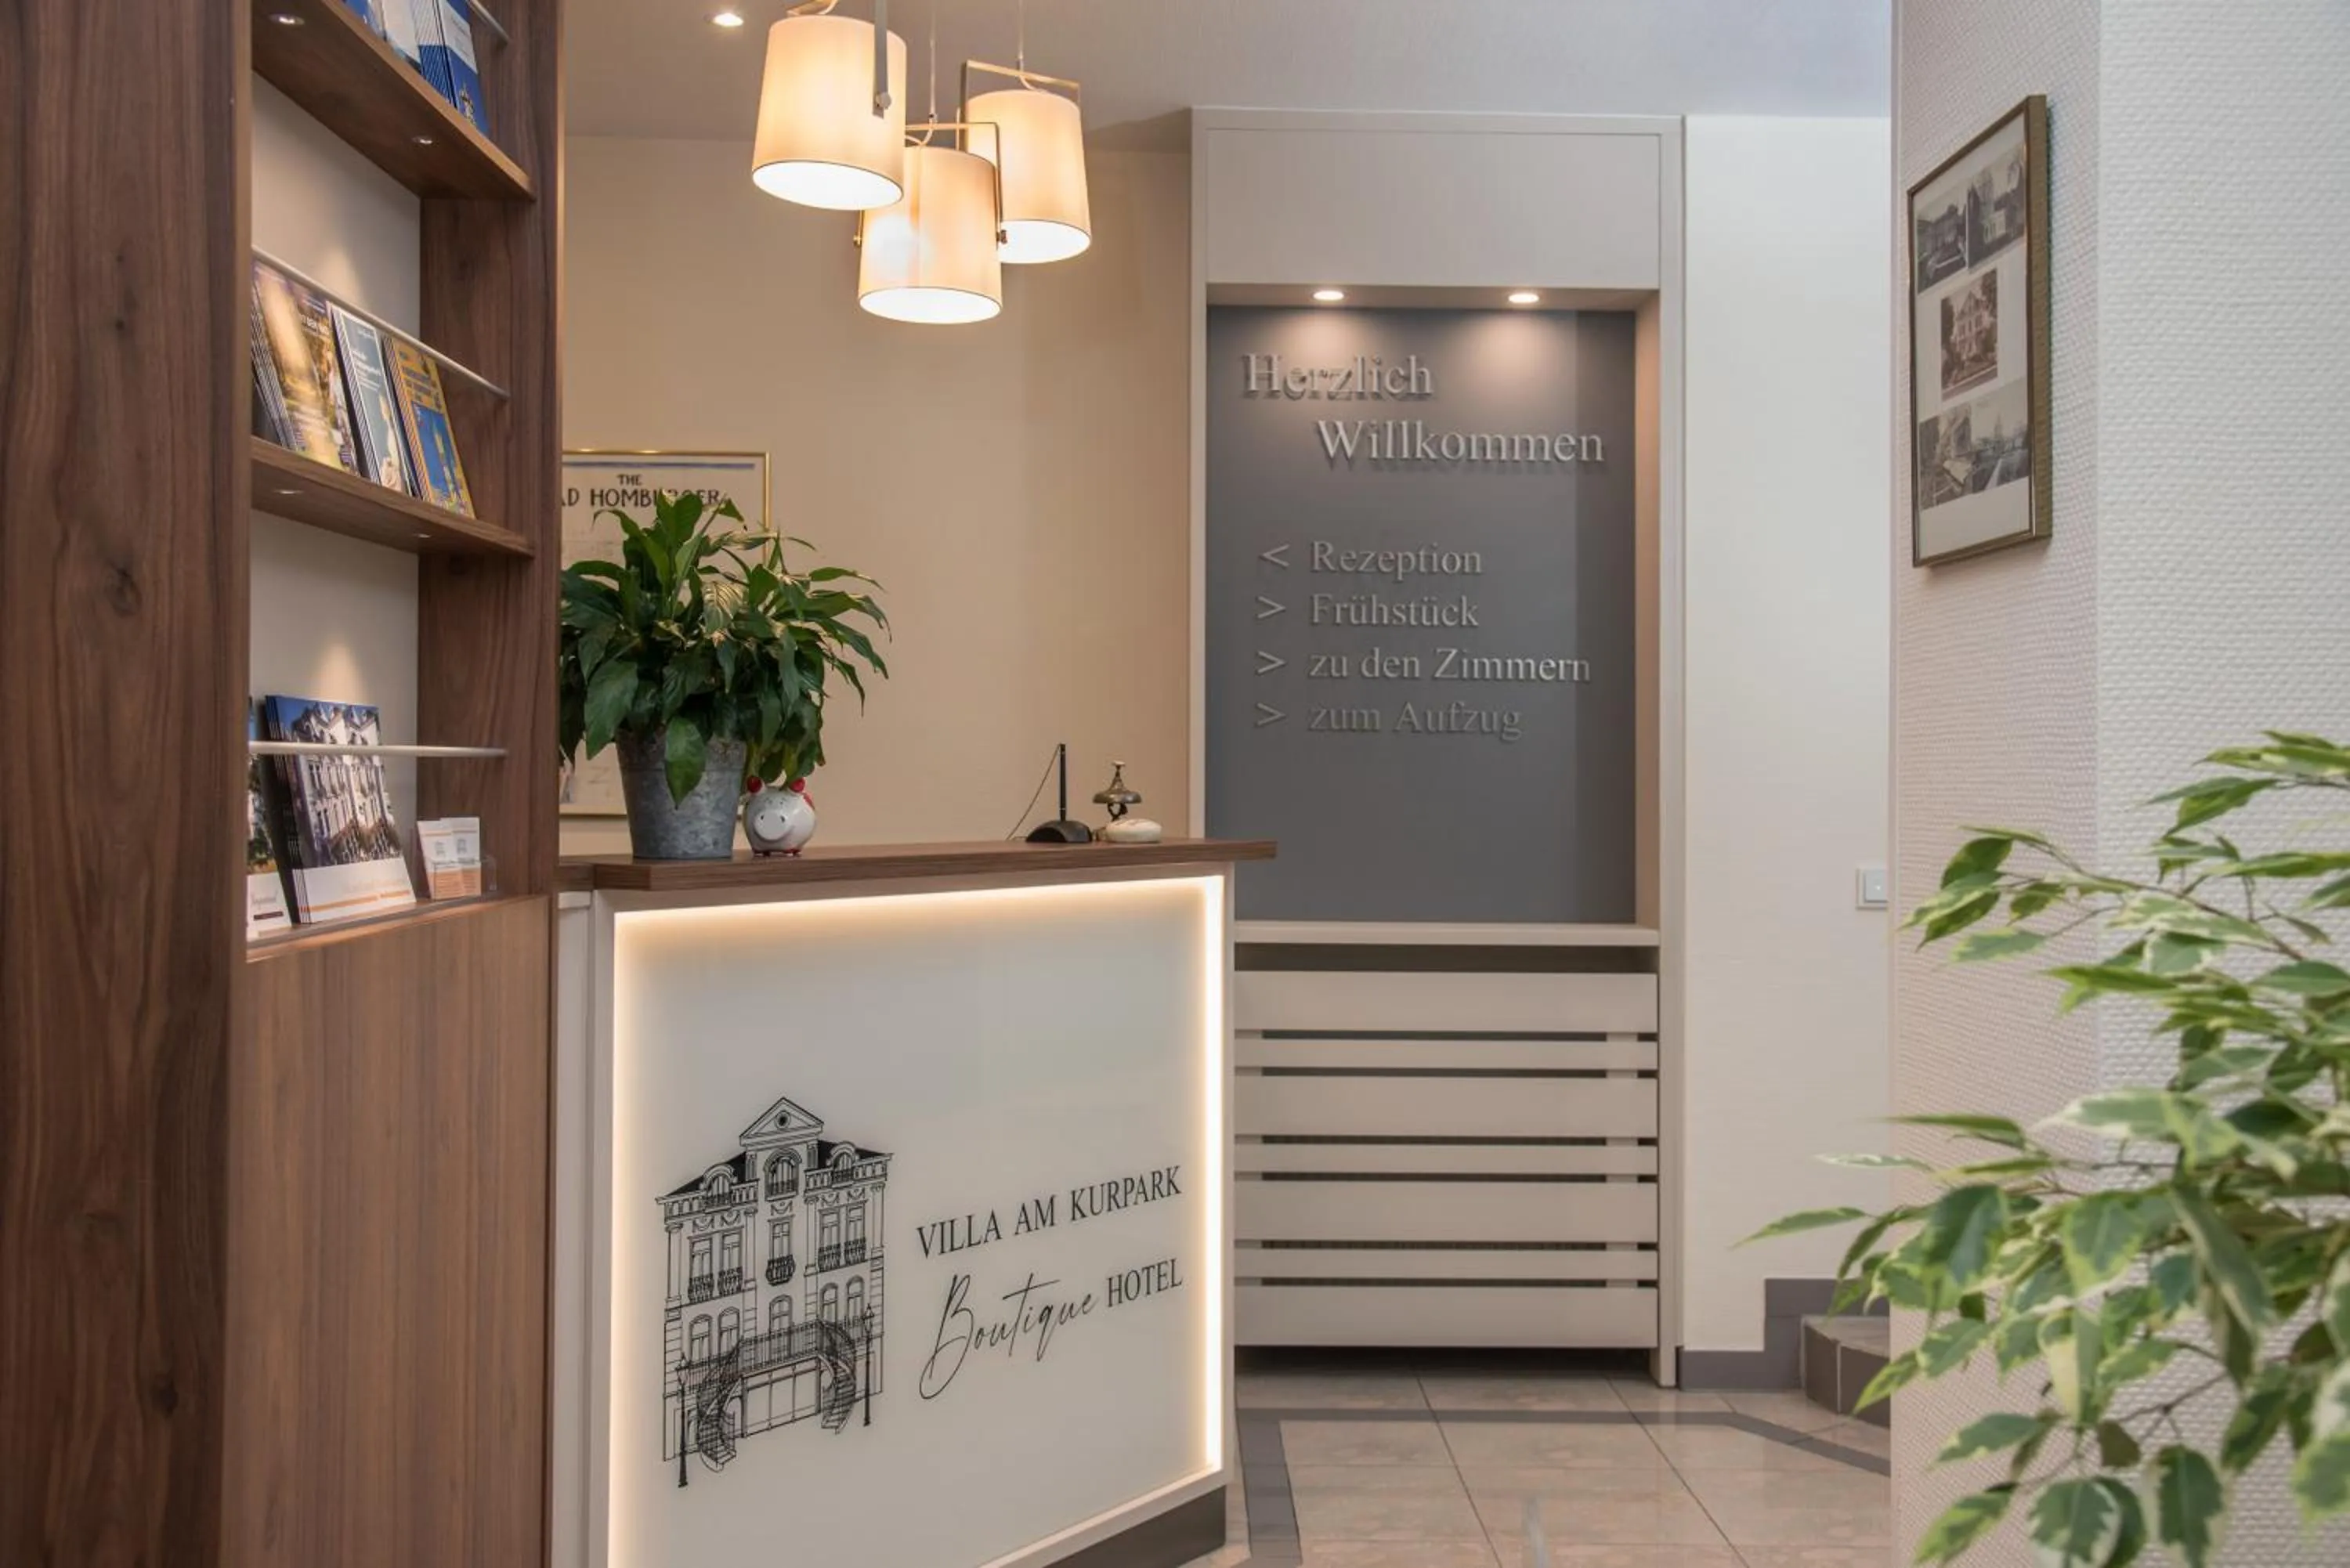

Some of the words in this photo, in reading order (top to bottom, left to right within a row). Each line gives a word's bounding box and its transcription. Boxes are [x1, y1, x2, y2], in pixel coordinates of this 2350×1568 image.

[1244, 354, 1434, 396] Herzlich
[1316, 418, 1604, 462] Willkommen
[616, 473, 642, 486] THE
[1311, 540, 1483, 582] Rezeption
[1311, 593, 1480, 627] Frühstück
[1309, 653, 1348, 679] zu
[1361, 647, 1421, 679] den
[1434, 648, 1591, 681] Zimmern
[1309, 707, 1381, 732] zum
[1393, 701, 1523, 741] Aufzug
[916, 1209, 1003, 1259] VILLA
[1014, 1194, 1057, 1236] AM
[1069, 1165, 1182, 1222] KURPARK
[919, 1272, 1098, 1400] Boutique
[1106, 1257, 1184, 1308] HOTEL
